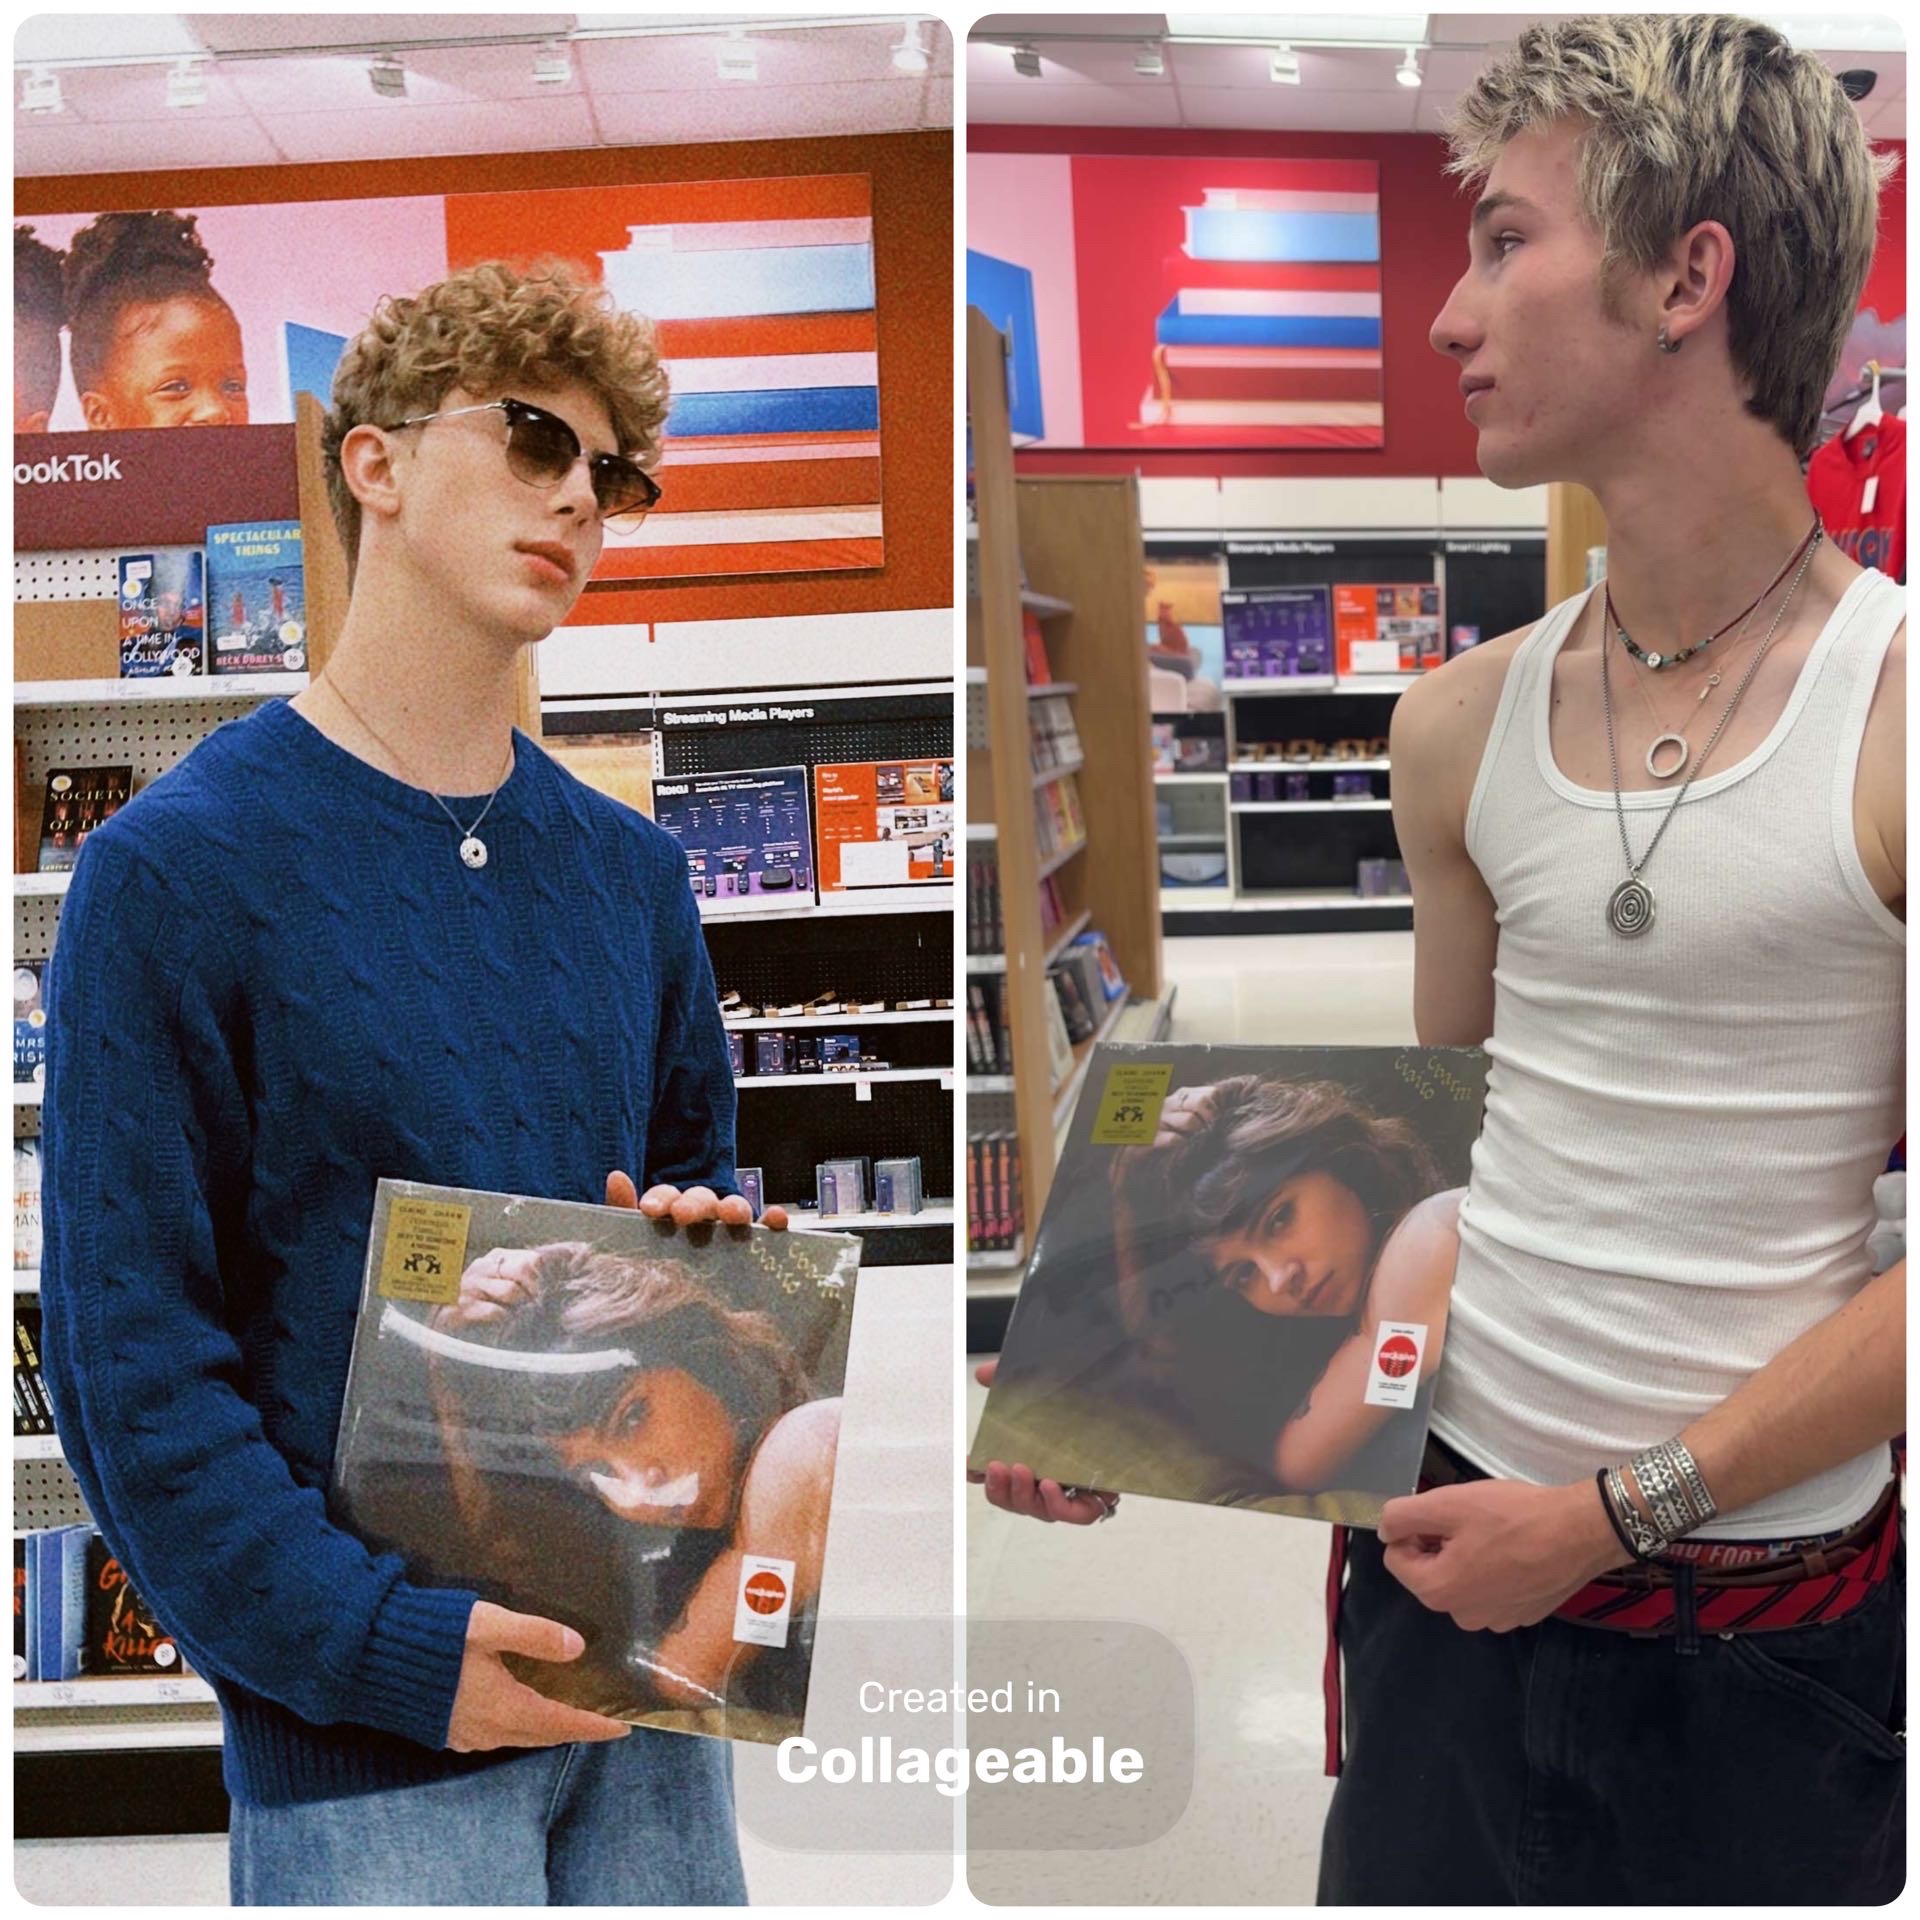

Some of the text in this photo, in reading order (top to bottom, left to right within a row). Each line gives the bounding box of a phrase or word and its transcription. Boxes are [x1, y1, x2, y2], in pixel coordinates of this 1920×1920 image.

[213, 528, 302, 546] SPECTACULAR
[235, 543, 281, 557] THINGS
[122, 597, 159, 611] ONCE
[122, 616, 159, 629] UPON
[122, 635, 132, 647] A
[164, 632, 177, 645] IN
[663, 707, 815, 725] Streaming Media Players
[49, 788, 128, 801] SOCIETY
[49, 819, 105, 831] OF LI
[15, 1037, 45, 1048] MRS
